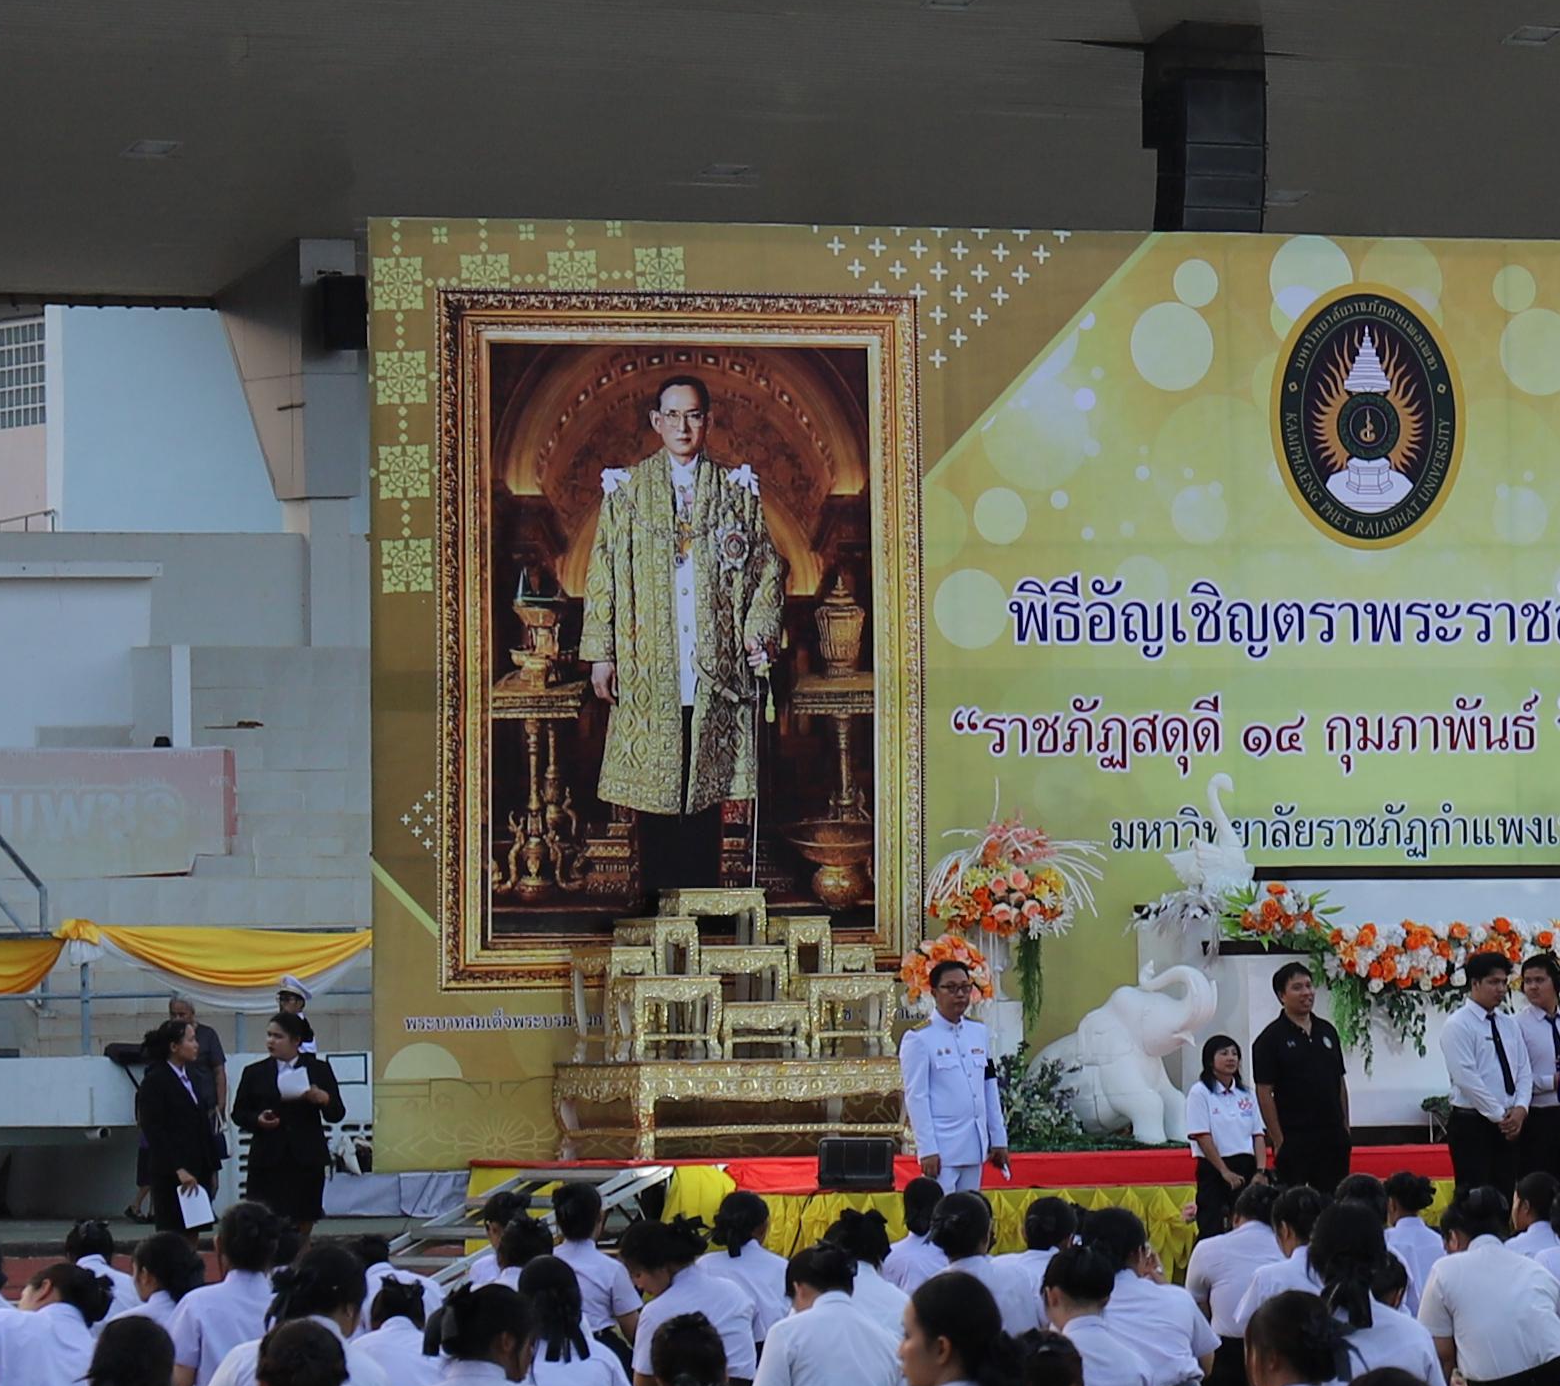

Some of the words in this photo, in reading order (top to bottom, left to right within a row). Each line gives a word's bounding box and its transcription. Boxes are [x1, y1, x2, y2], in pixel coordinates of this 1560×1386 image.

[1285, 412, 1322, 503] KAMPHAENG
[1319, 501, 1352, 529] PHET
[1354, 502, 1422, 538] RAJABHAT
[1420, 418, 1451, 503] UNIVERSITY
[1242, 714, 1306, 757] ๑๔
[1325, 692, 1540, 774] กุมภาพันธ์
